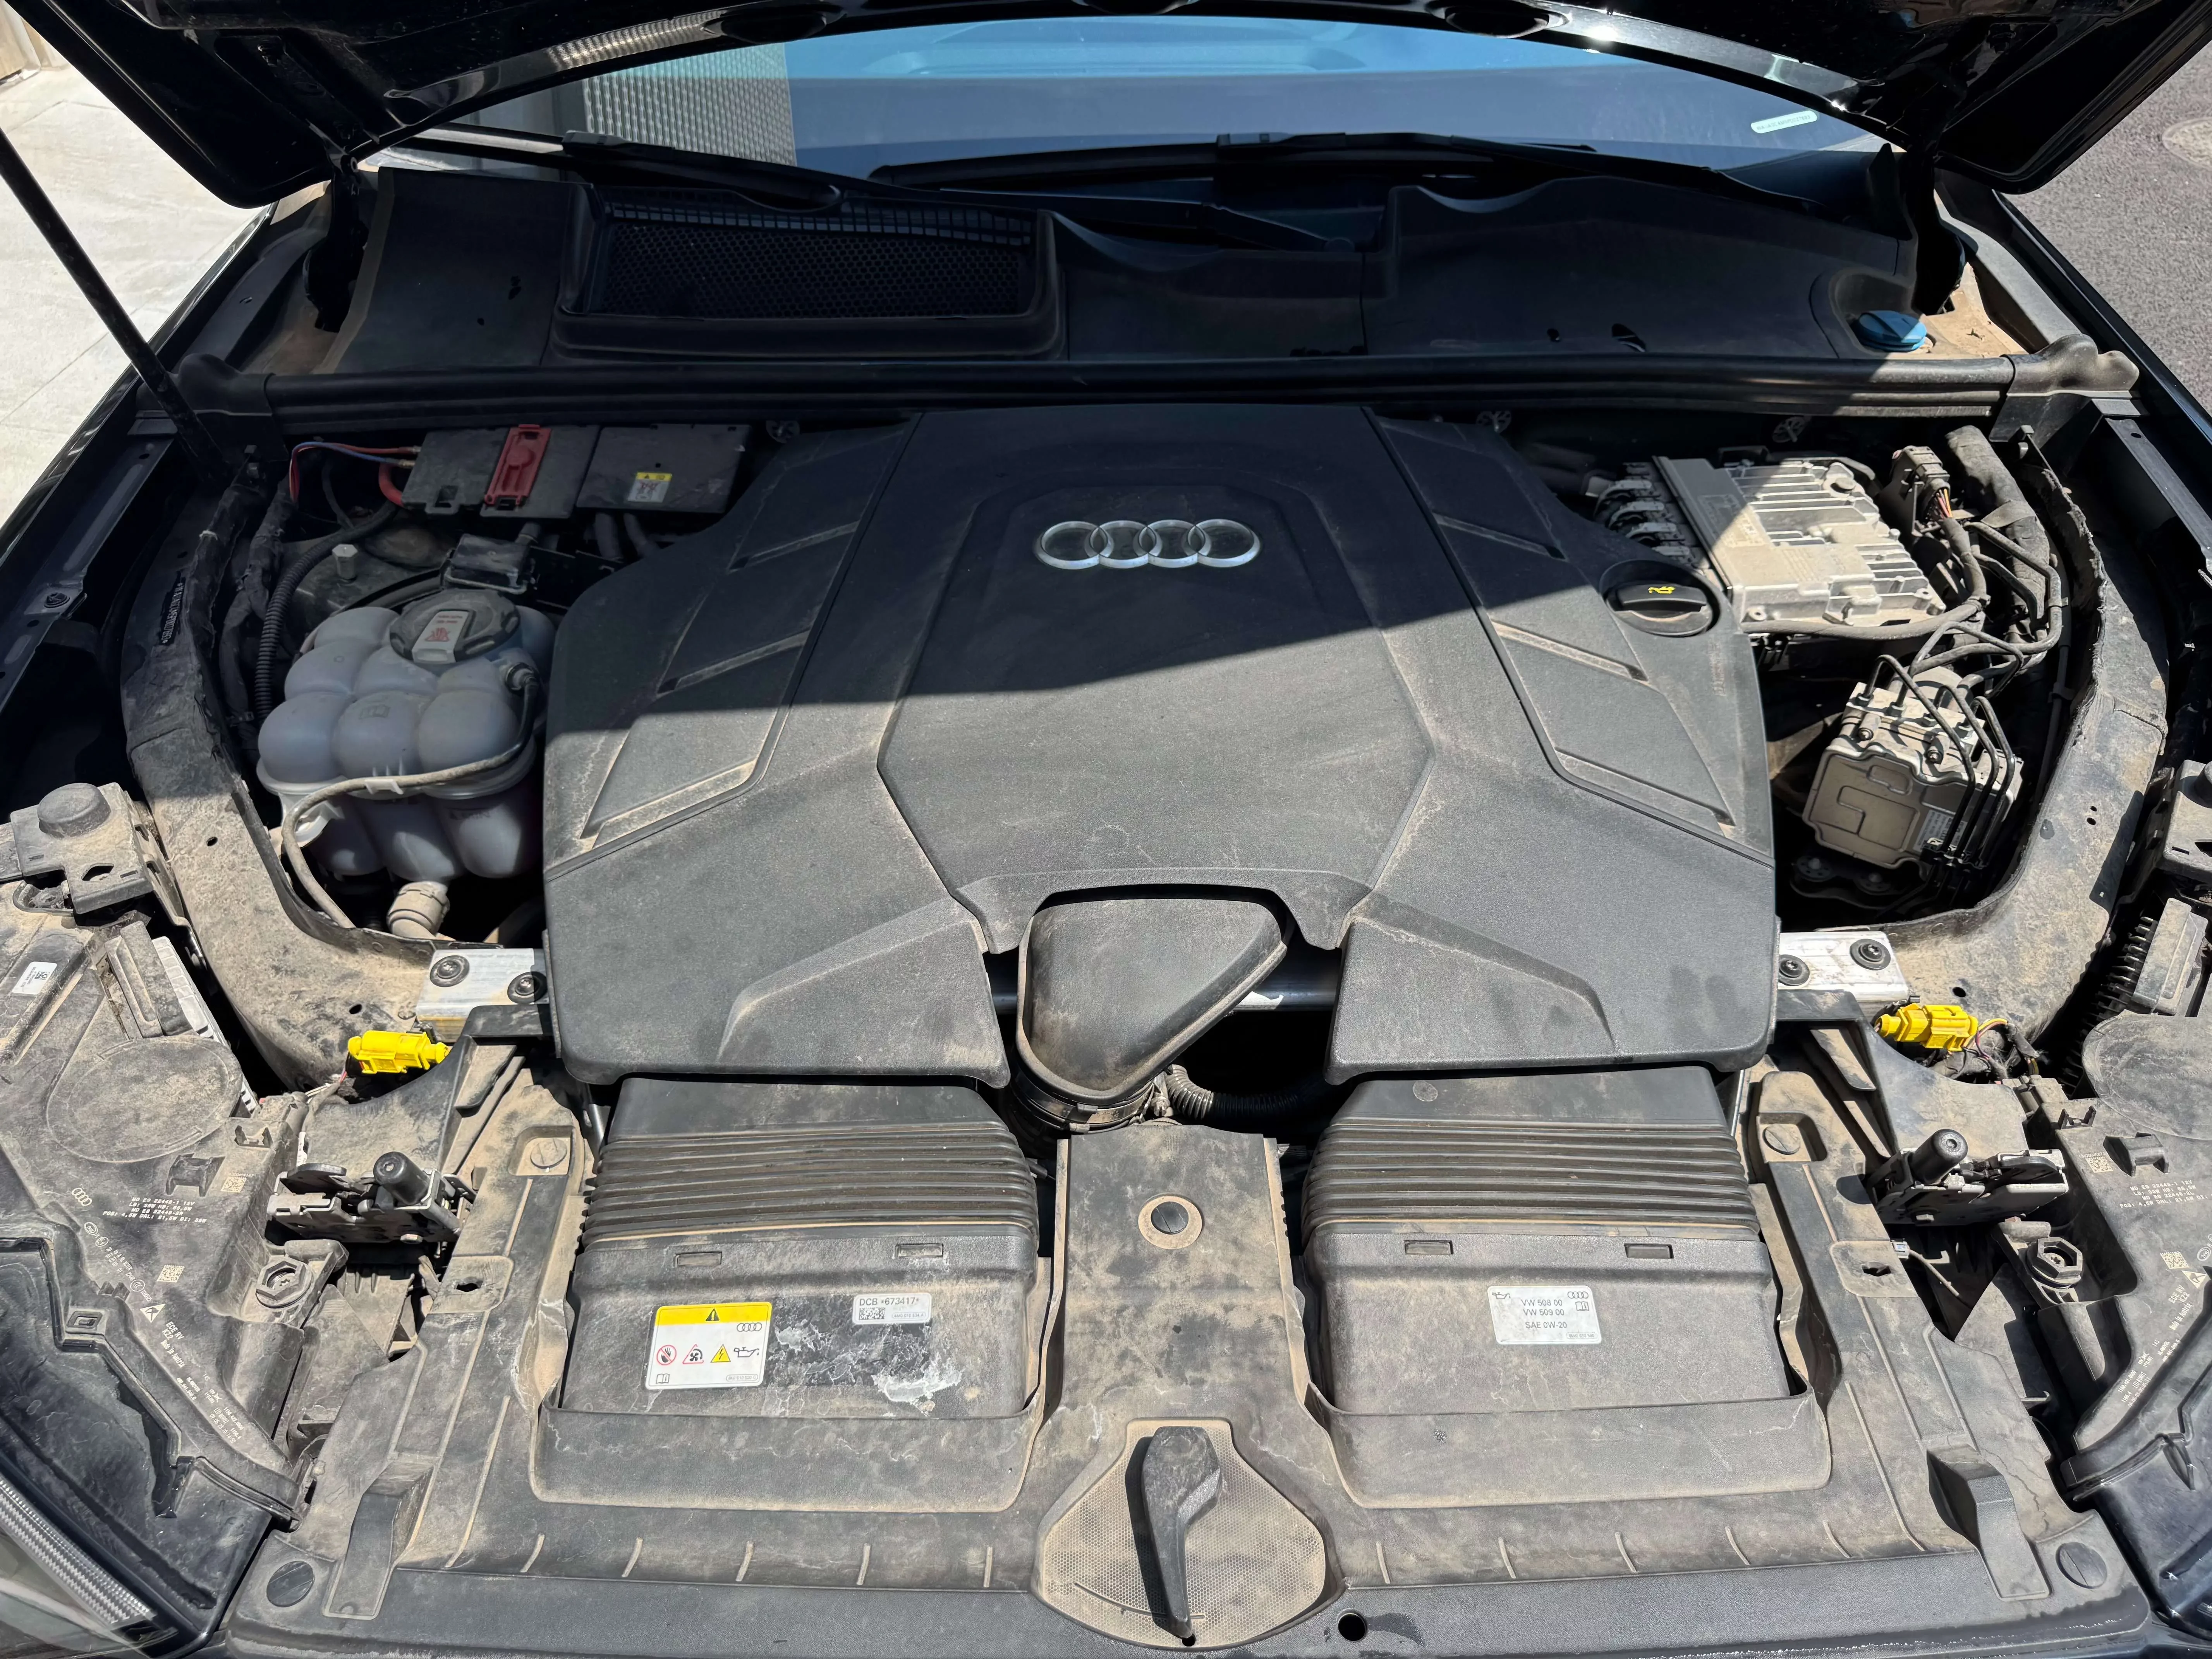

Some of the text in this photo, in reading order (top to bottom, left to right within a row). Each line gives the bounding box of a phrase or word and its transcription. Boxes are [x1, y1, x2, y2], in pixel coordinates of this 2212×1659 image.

[161, 1328, 174, 1340] KZ2
[166, 1321, 185, 1340] ECE RV
[172, 1353, 185, 1368] Austria
